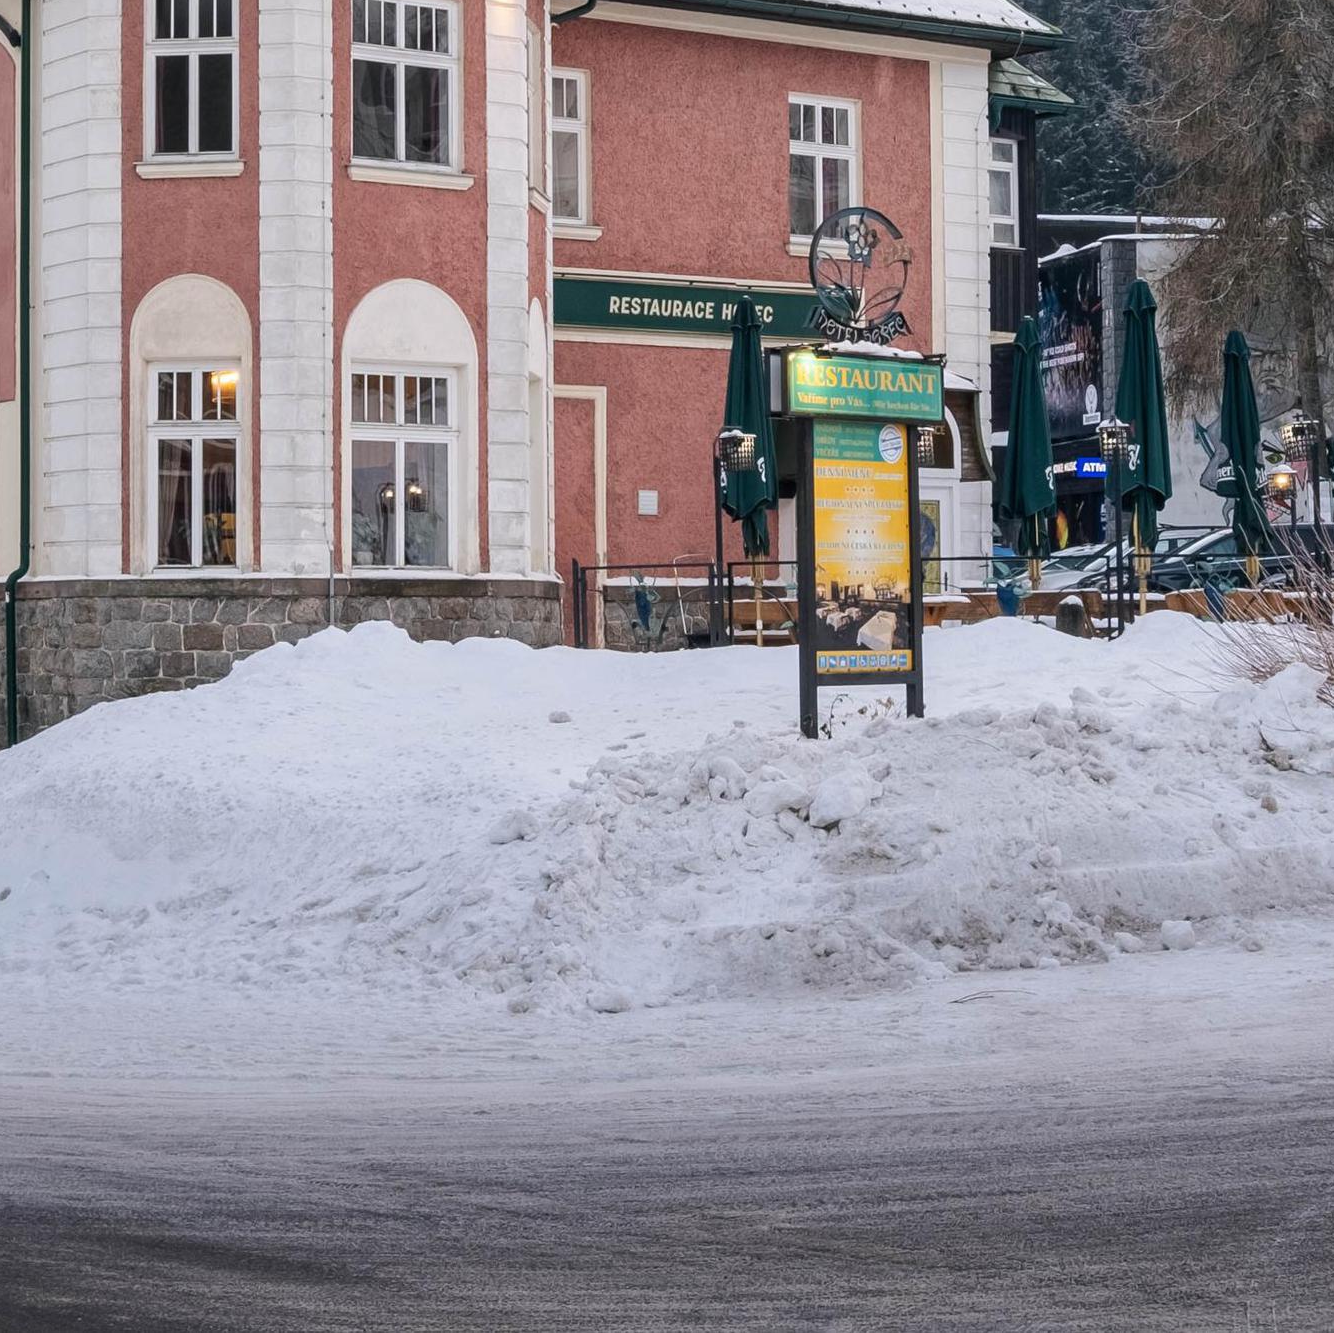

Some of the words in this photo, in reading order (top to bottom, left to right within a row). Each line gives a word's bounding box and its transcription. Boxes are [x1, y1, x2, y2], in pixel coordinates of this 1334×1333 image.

[609, 295, 715, 320] RESTAURACE
[722, 303, 773, 323] HEC
[796, 362, 937, 394] RESTAURANT
[1083, 463, 1107, 472] ATM
